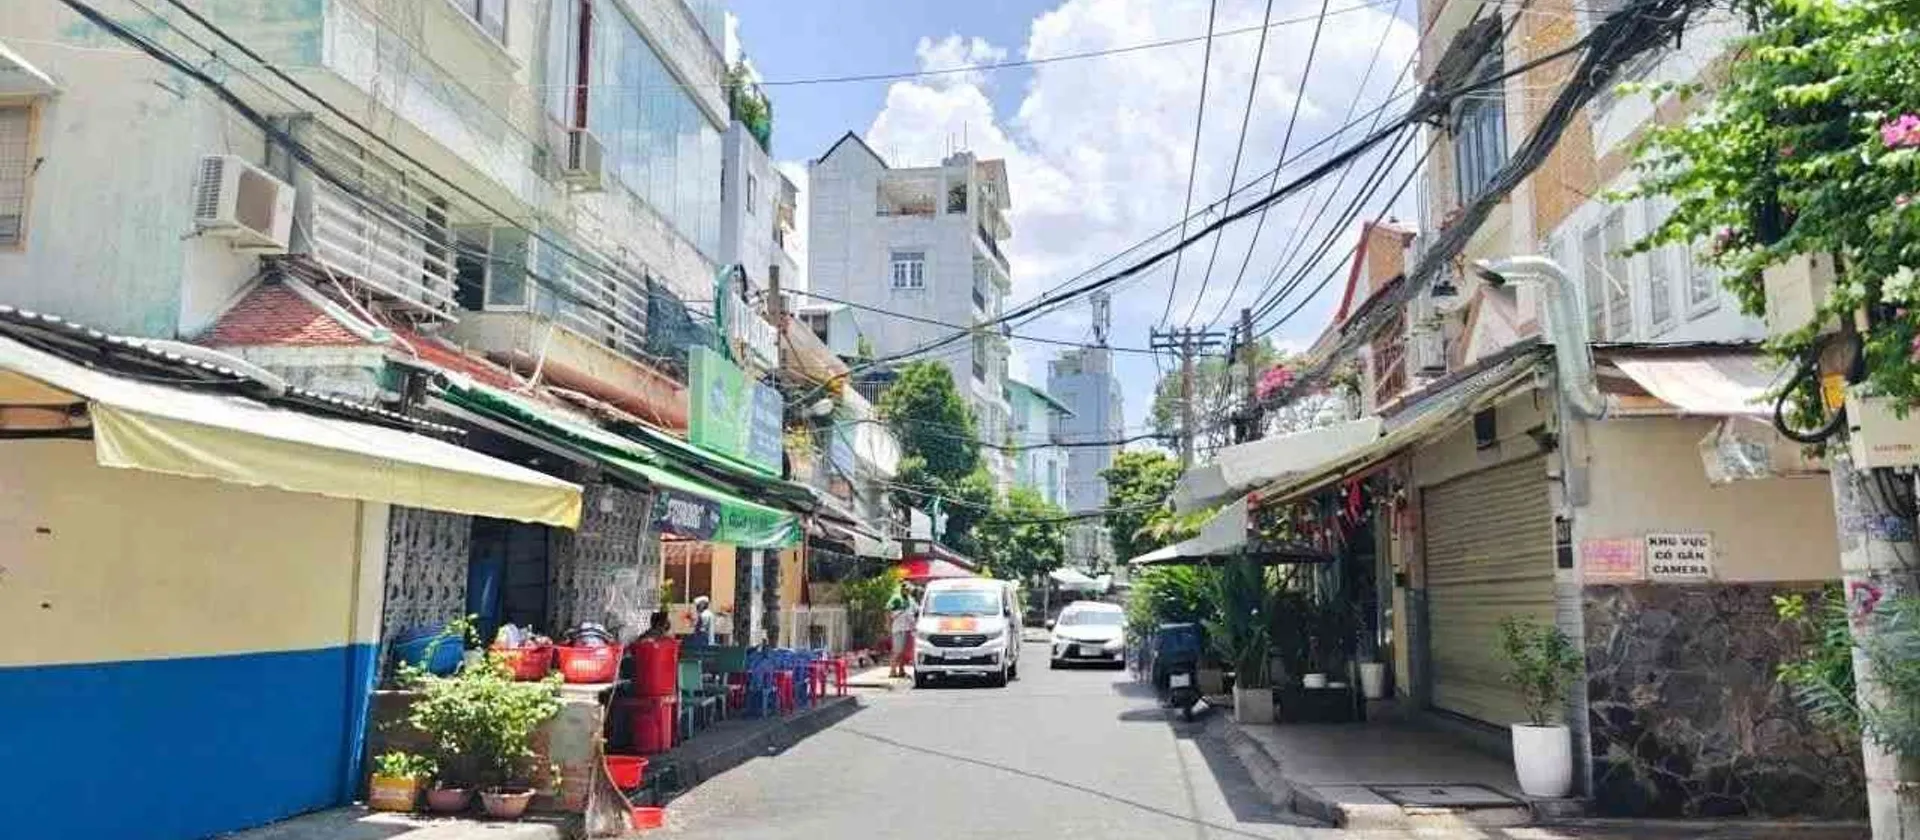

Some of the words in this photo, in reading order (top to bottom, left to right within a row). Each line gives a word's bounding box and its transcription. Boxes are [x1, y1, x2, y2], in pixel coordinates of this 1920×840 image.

[1649, 537, 1677, 546] KHU
[1655, 549, 1672, 560] CÓ
[1653, 565, 1708, 574] CAMERA
